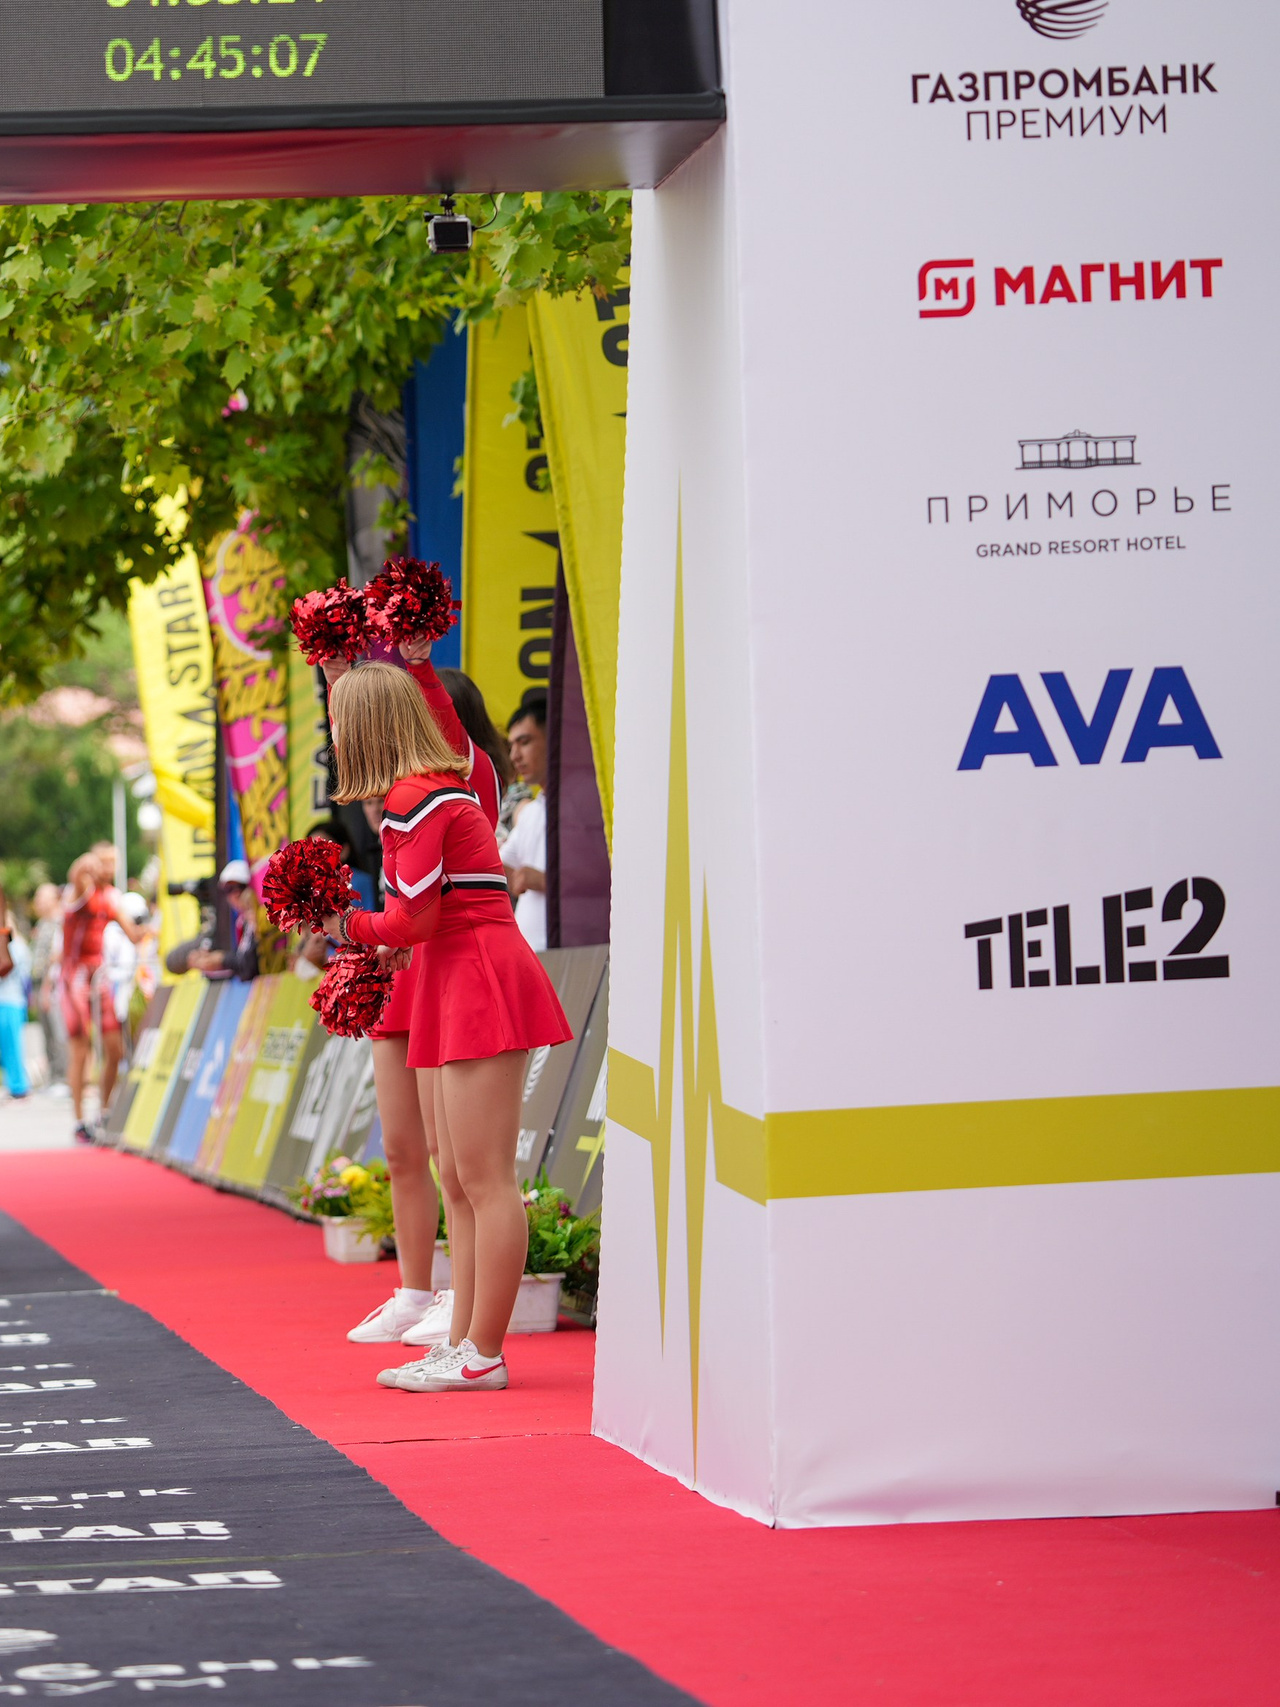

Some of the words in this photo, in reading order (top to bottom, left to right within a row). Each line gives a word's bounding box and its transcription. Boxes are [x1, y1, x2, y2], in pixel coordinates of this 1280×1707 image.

[104, 33, 329, 82] 04:45:07
[910, 62, 1218, 104] ГАЗПРОМБАНК
[966, 103, 1168, 141] ПРЕМИУМ
[993, 257, 1224, 306] МАГНИТ
[927, 484, 1232, 524] ПРИМОРЬЕ
[975, 541, 1042, 559] GRAND
[1048, 537, 1121, 555] RESORT
[1126, 535, 1187, 552] HOTEL
[158, 582, 202, 687] STAR
[956, 665, 1224, 772] AVA
[964, 876, 1231, 990] TELE2
